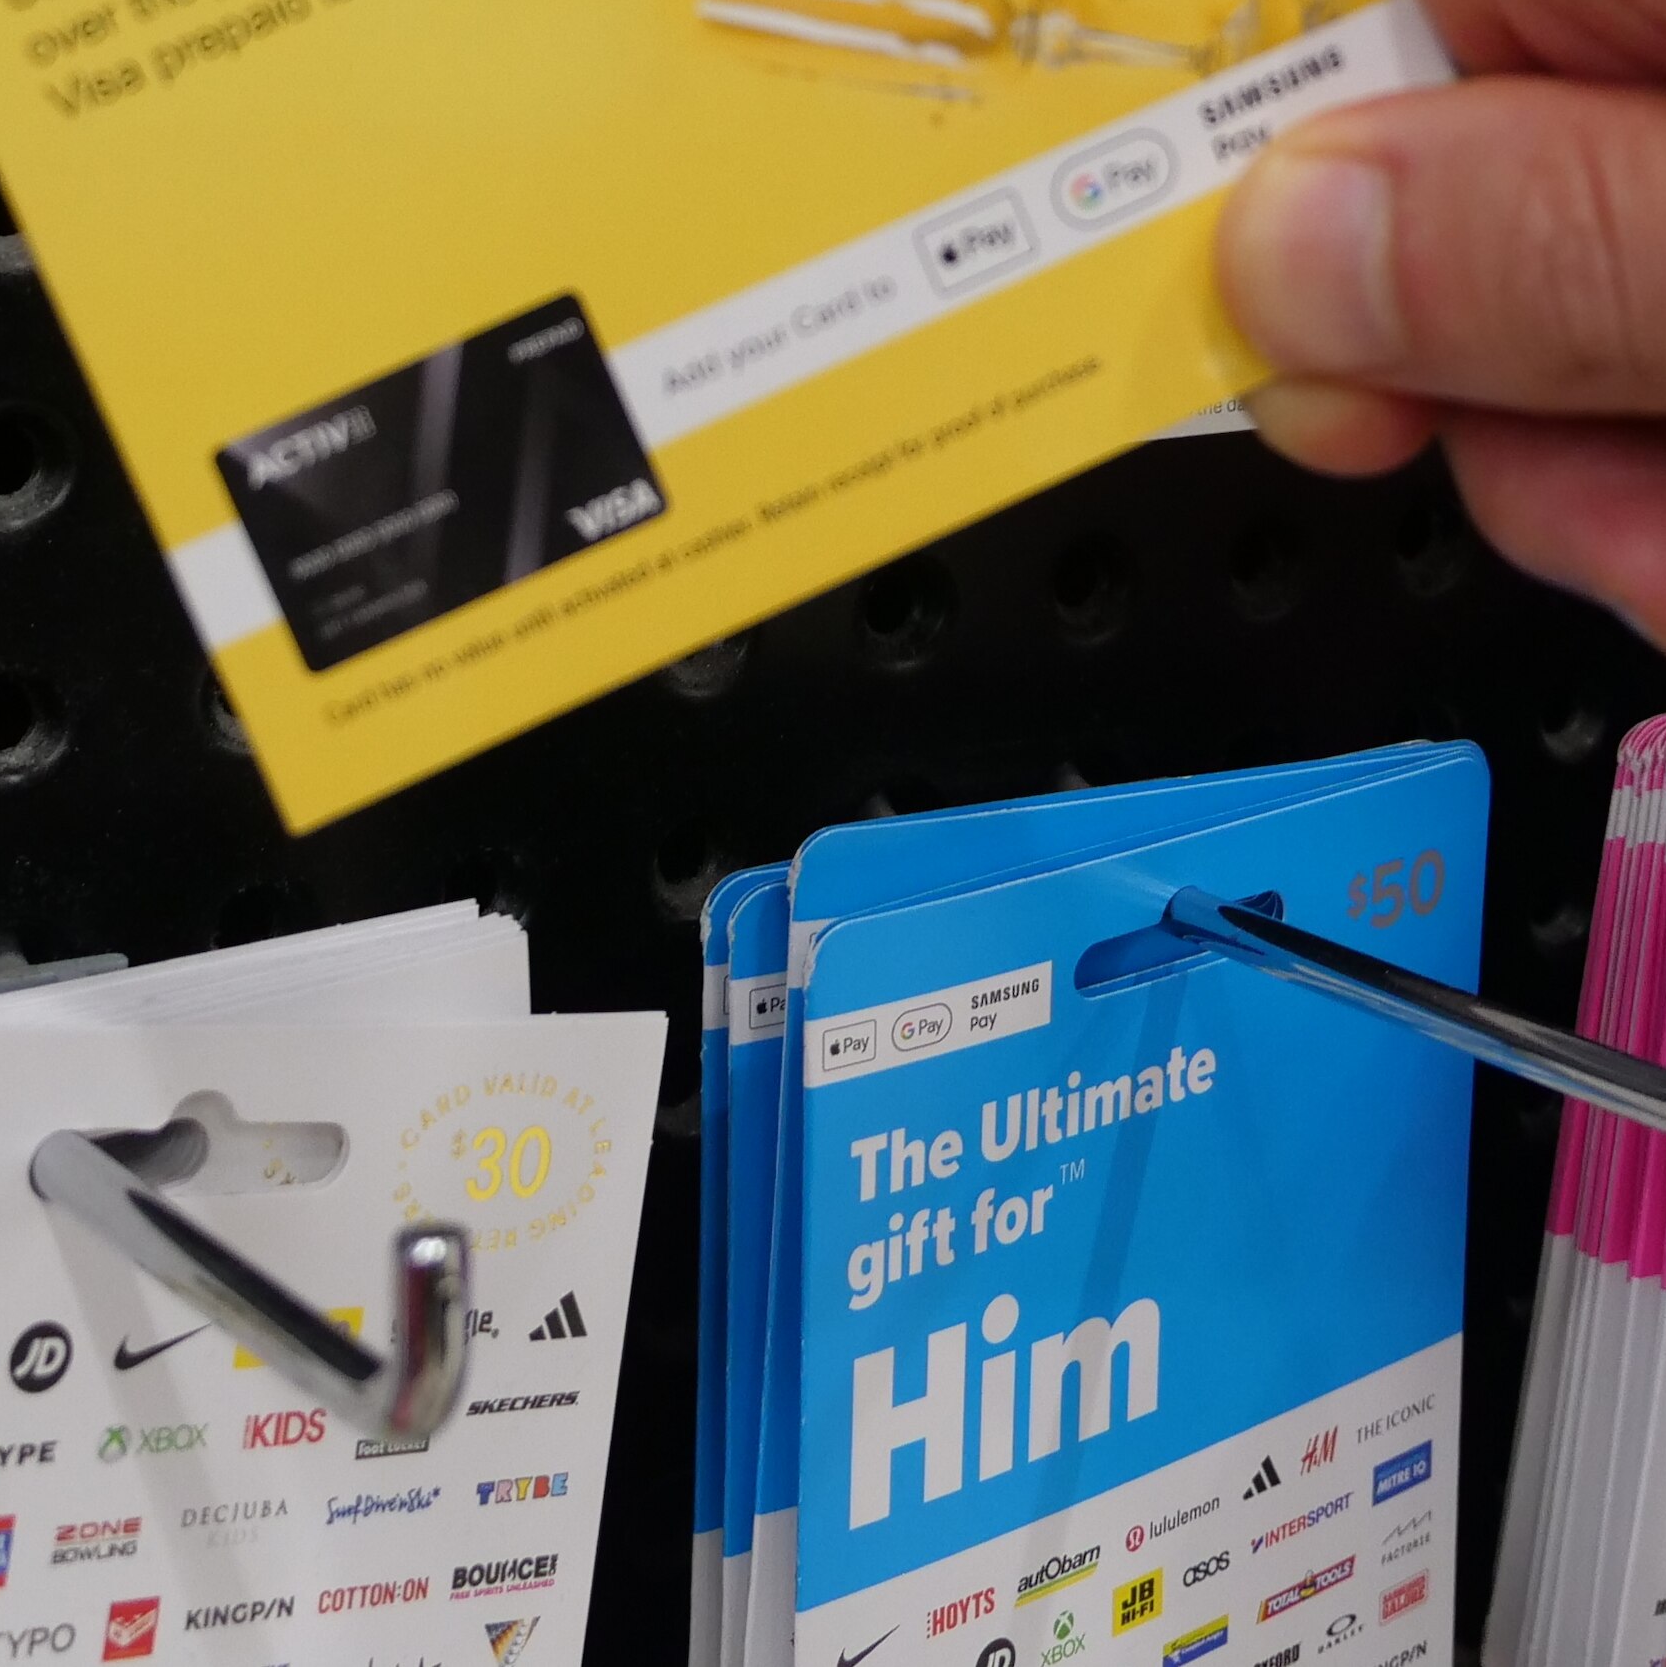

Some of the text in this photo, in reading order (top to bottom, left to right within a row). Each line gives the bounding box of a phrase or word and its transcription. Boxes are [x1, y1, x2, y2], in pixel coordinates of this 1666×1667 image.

[25, 6, 120, 68] over
[44, 60, 146, 123] Visa
[1196, 45, 1347, 129] SAMSUNG
[789, 289, 864, 339] Card
[566, 477, 663, 542] VISA
[1346, 848, 1445, 929] $50
[971, 977, 1041, 1011] SAMSUNG
[917, 1016, 944, 1038] Pay
[970, 1012, 997, 1032] Pay
[843, 1034, 870, 1054] Pay
[483, 1072, 559, 1099] VALID
[850, 1045, 1218, 1203] The Ultimate
[450, 1125, 552, 1201] $30
[846, 1207, 955, 1311] gift
[971, 1184, 1054, 1248] for
[16, 1336, 66, 1379] JD
[251, 1408, 327, 1448] KIDS
[848, 1293, 1161, 1531] Him
[1357, 1393, 1436, 1444] THE ICONIC
[136, 1423, 209, 1455] XBOX
[476, 1472, 568, 1505] TRYBE
[1376, 1464, 1410, 1496] MITRE
[55, 1517, 143, 1542] ZONE
[1149, 1497, 1220, 1540] lululemon
[1264, 1491, 1354, 1549] INTERSPORT
[51, 1540, 138, 1566] BOWLING
[1017, 1545, 1101, 1594] autObarn
[1182, 1550, 1230, 1588] asos
[1122, 1577, 1155, 1610] JB
[1314, 1559, 1353, 1590] TOOLS
[932, 1587, 995, 1638] HOYTS
[1121, 1599, 1155, 1627] HI-FI
[1040, 1634, 1086, 1667] XBOX
